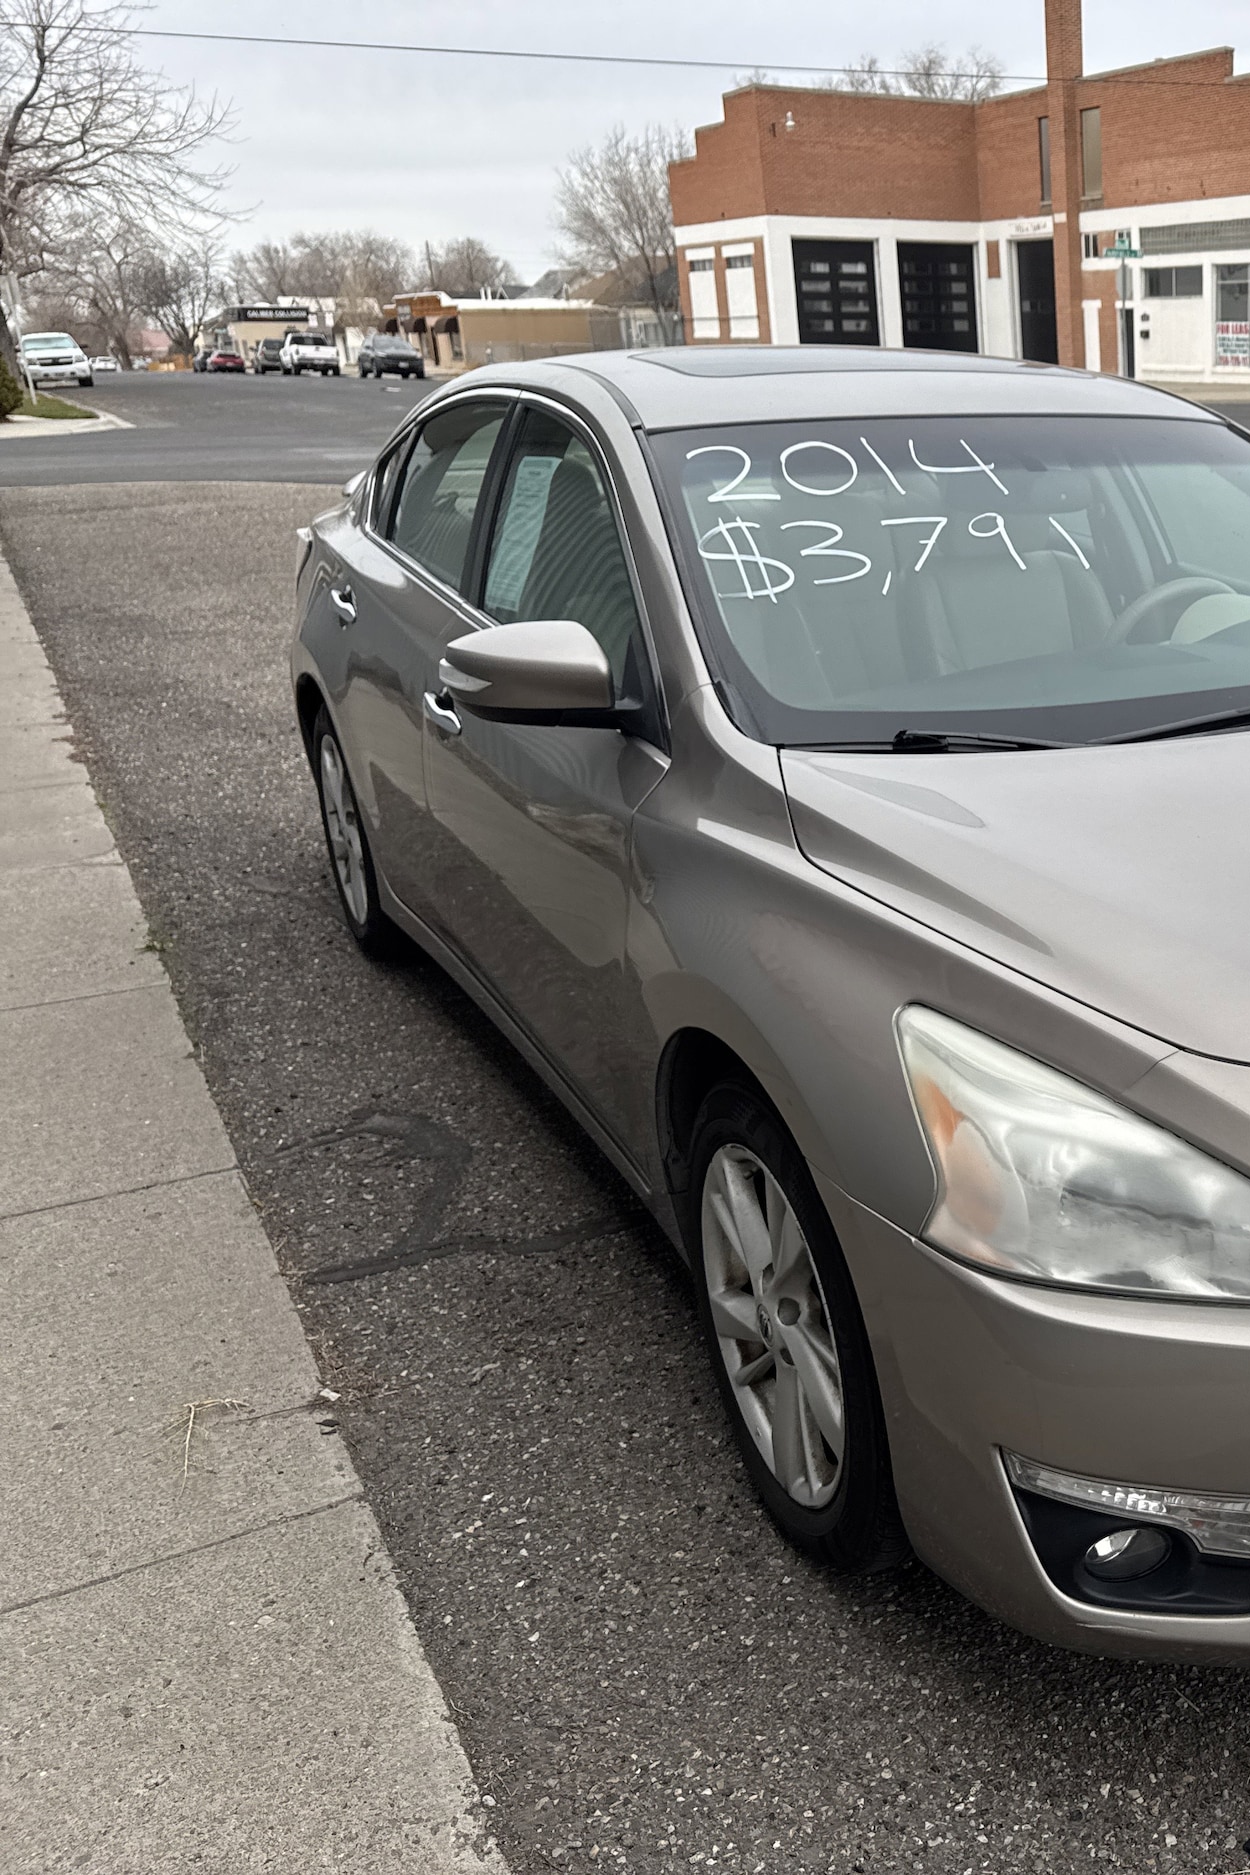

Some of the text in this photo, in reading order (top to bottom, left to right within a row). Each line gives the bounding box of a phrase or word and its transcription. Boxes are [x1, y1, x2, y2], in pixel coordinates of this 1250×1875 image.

[1216, 323, 1230, 335] FOR
[685, 436, 1009, 502] 2014
[697, 511, 1091, 605] $3,791
